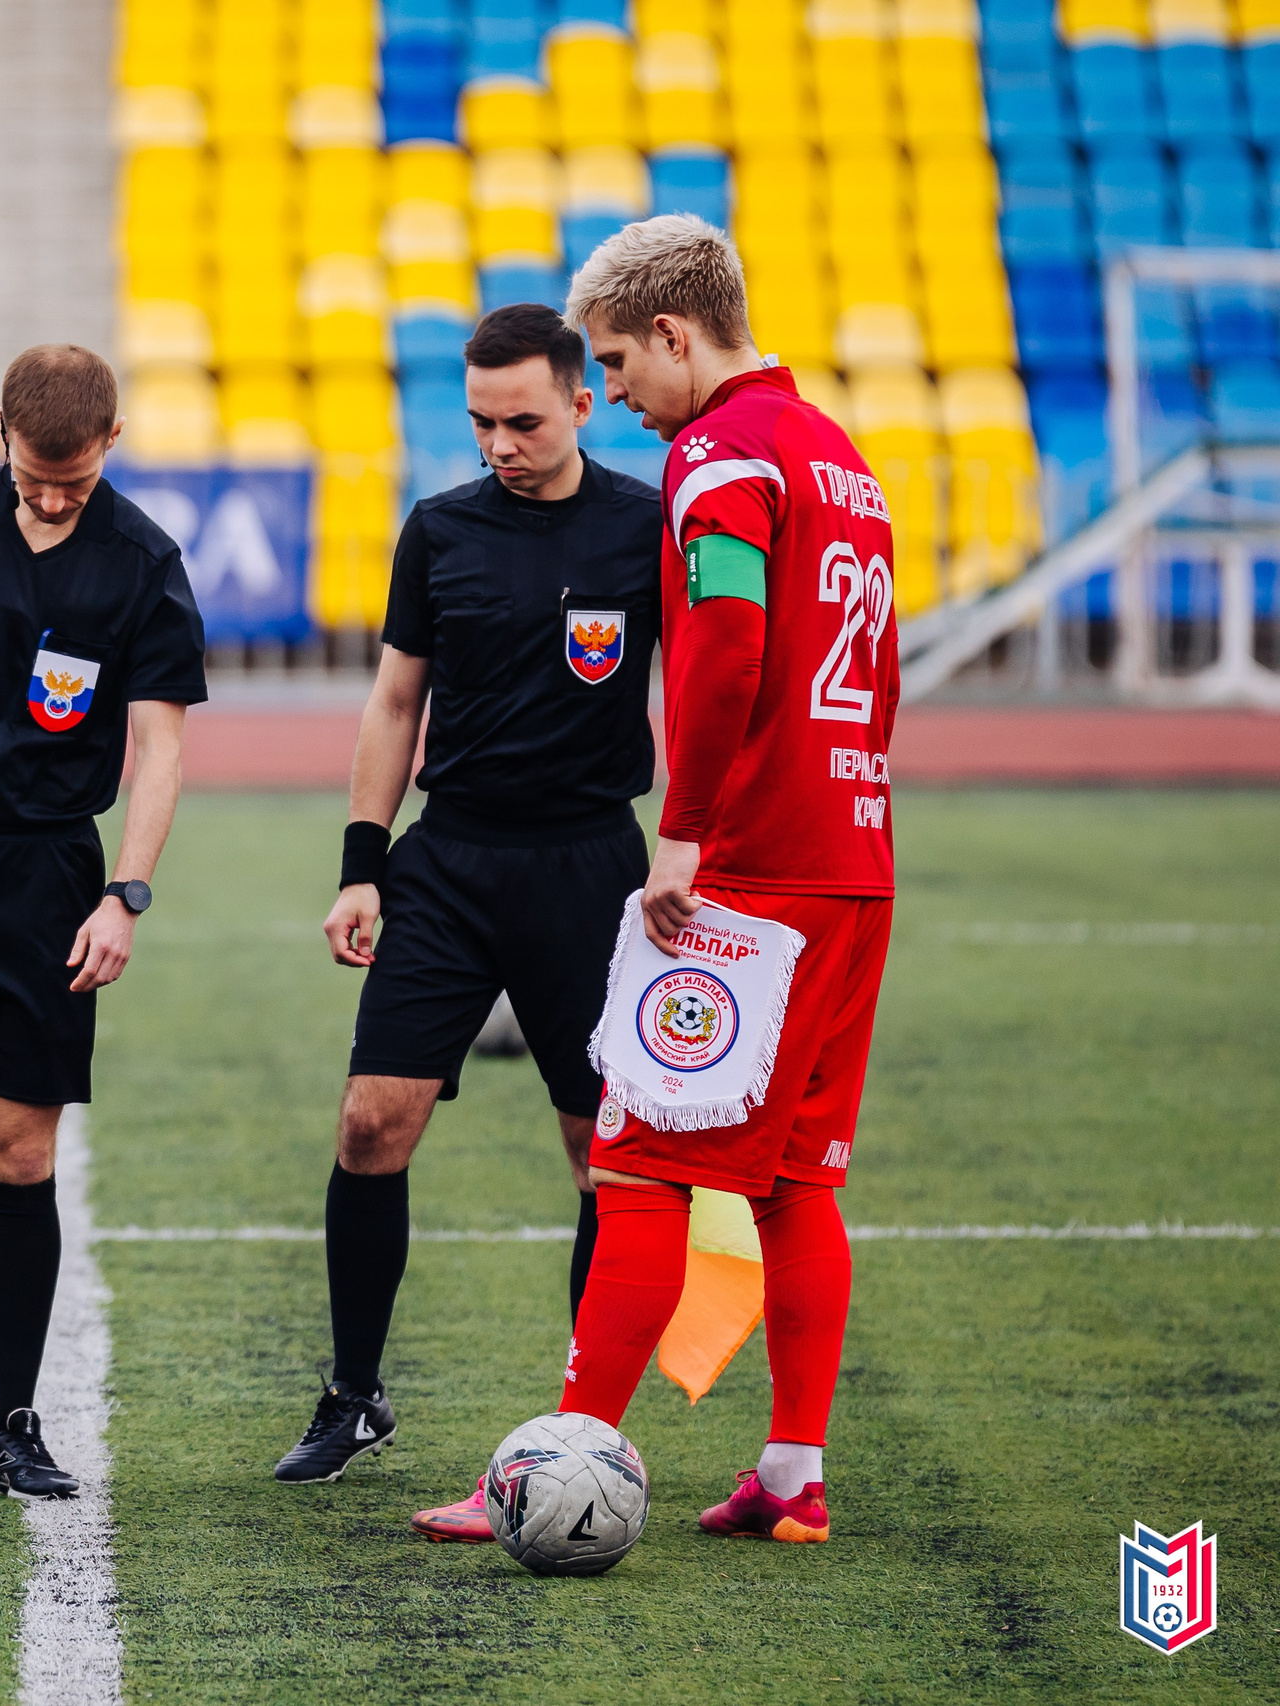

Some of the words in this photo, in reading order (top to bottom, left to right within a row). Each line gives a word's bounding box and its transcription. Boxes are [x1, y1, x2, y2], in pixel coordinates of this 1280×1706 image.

[732, 932, 758, 946] КЛУБ
[664, 977, 681, 990] ФК
[684, 976, 727, 1003] ИЛЬПАР
[651, 1037, 687, 1062] ПЕРМСКИЙ
[690, 1051, 711, 1062] КРАЙ
[662, 1075, 684, 1088] 2024
[665, 1086, 677, 1095] год
